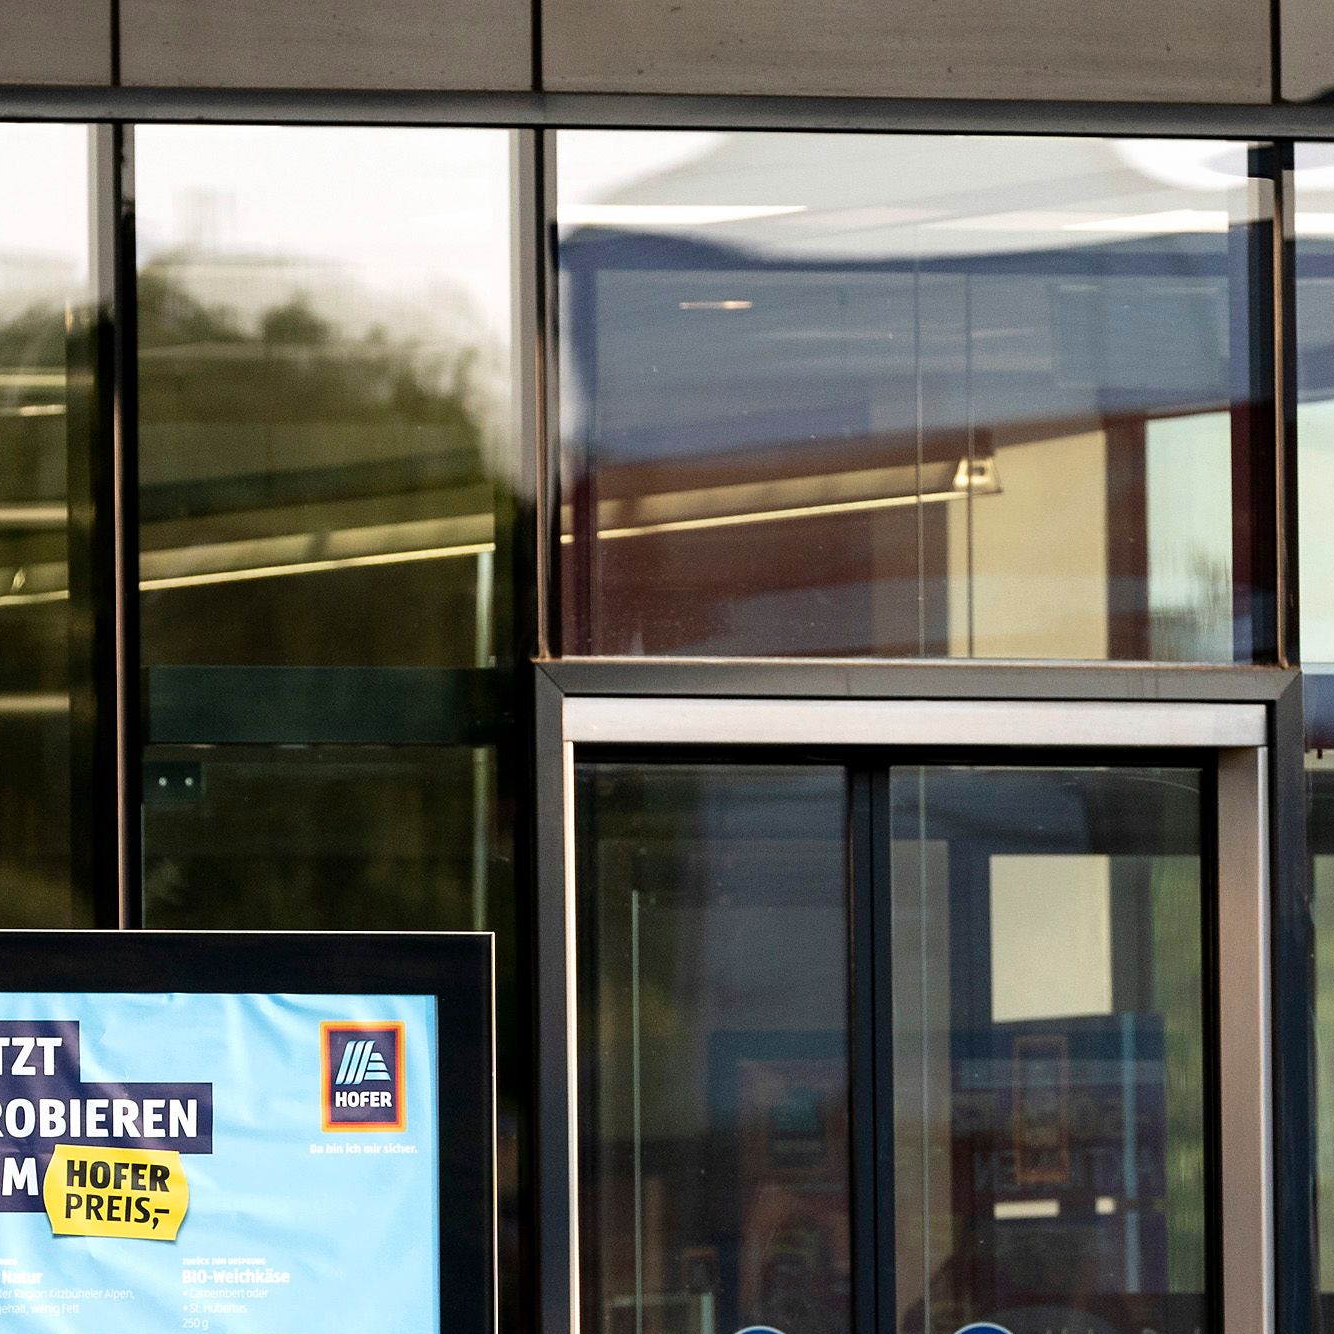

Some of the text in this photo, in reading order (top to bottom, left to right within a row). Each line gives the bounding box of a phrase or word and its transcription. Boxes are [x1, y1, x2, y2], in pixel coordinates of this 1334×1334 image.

[335, 1091, 393, 1108] HOFER
[310, 1143, 418, 1154] Da bin ich mir sicher.
[66, 1160, 171, 1193] HOFER
[64, 1193, 170, 1230] PREIS,-
[182, 1269, 290, 1284] BIO-Weichkäse
